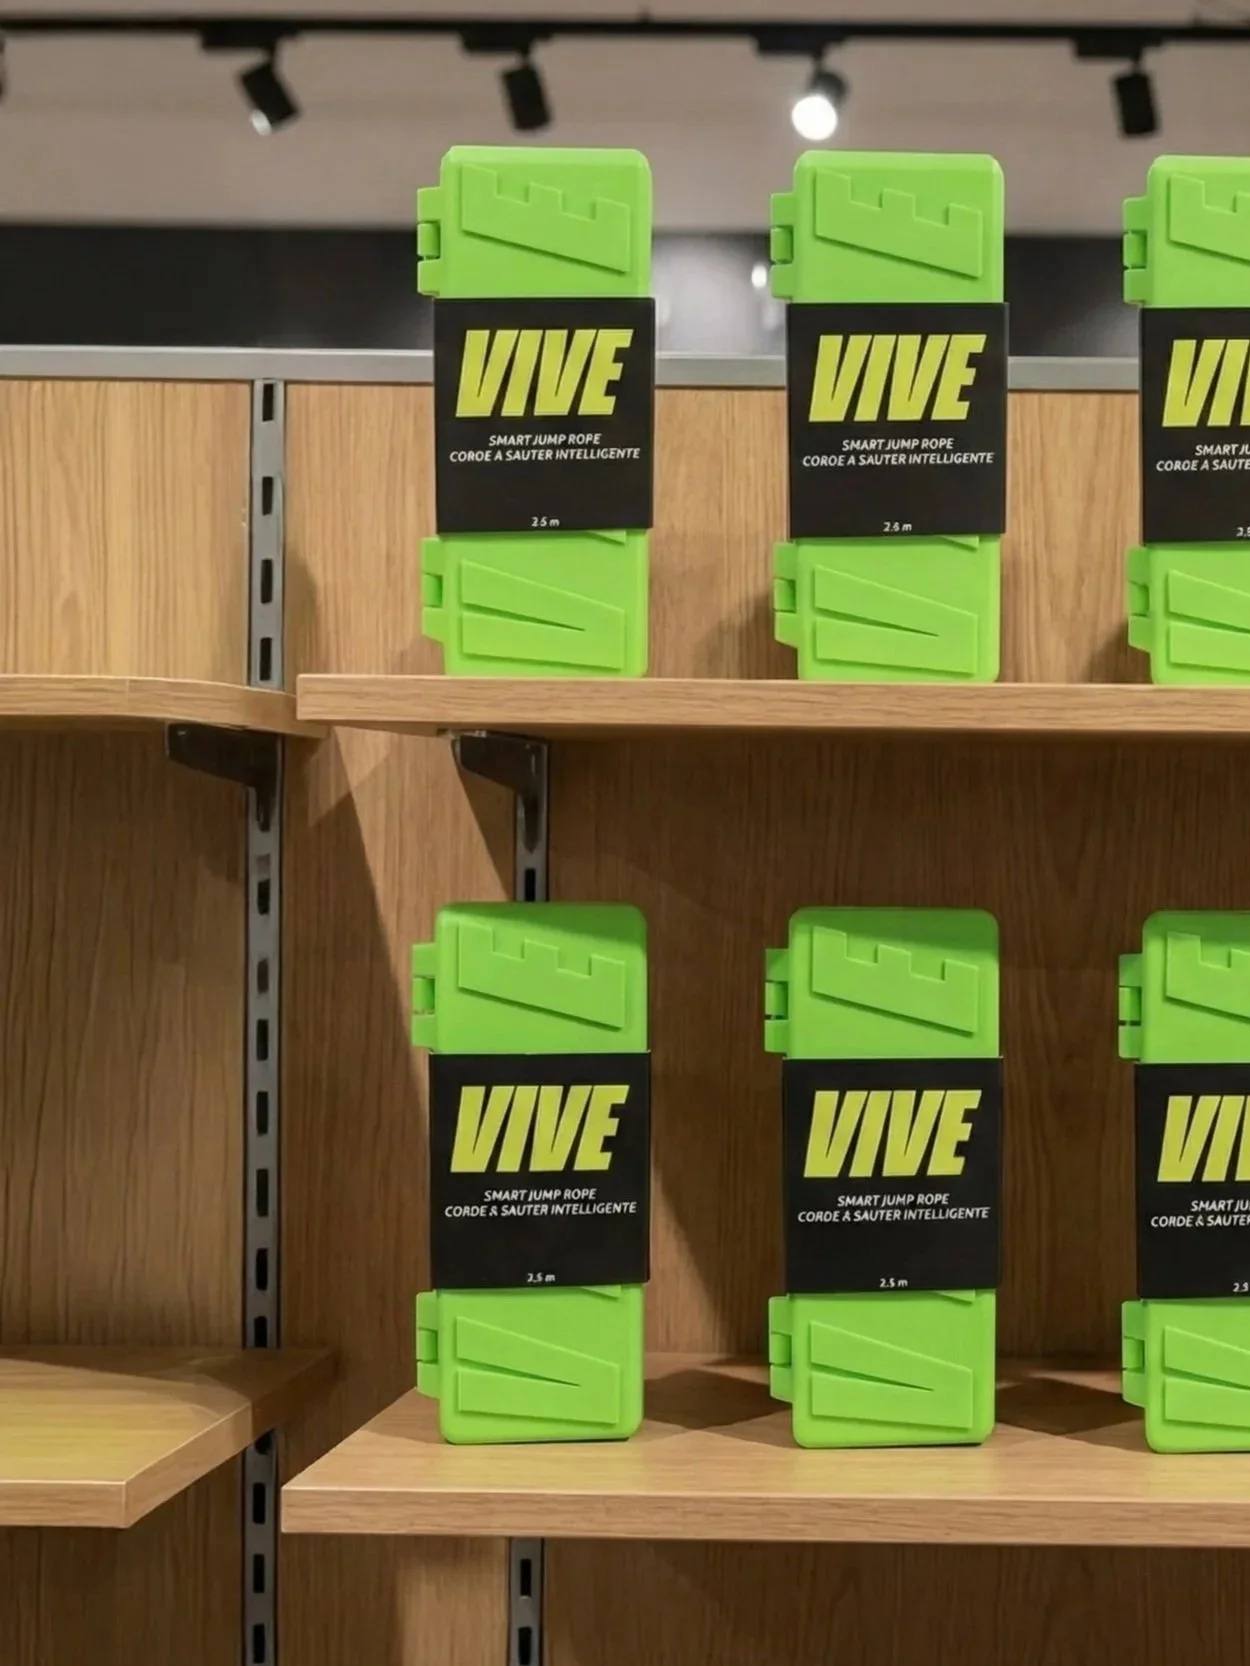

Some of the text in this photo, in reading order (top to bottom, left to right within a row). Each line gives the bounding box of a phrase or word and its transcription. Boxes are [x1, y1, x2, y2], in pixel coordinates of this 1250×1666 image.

[456, 329, 633, 417] VIVE
[809, 334, 986, 422] VIVE
[488, 434, 602, 446] SMART JUMP ROPE
[841, 438, 955, 451] SMART JUMP ROPE
[505, 449, 554, 461] SAUTER
[555, 448, 641, 459] INTELLIGENTE
[1194, 444, 1239, 456] SMART
[857, 454, 907, 465] SAUTER
[908, 452, 995, 464] INTELLIGENTE
[549, 518, 560, 527] m
[901, 523, 913, 532] m
[451, 1085, 629, 1172] VIVE
[804, 1090, 981, 1177] VIVE
[483, 1189, 597, 1201] SMART JUMP ROPE
[837, 1194, 950, 1207] SMART JUMP ROPE
[500, 1204, 549, 1216] SAUTER
[550, 1202, 637, 1214] INTELLIGENTE
[1190, 1200, 1233, 1211] SMART
[853, 1209, 902, 1221] SAUTER
[903, 1207, 991, 1219] INTELLIGENTE
[544, 1274, 556, 1282] m
[897, 1279, 908, 1287] m
